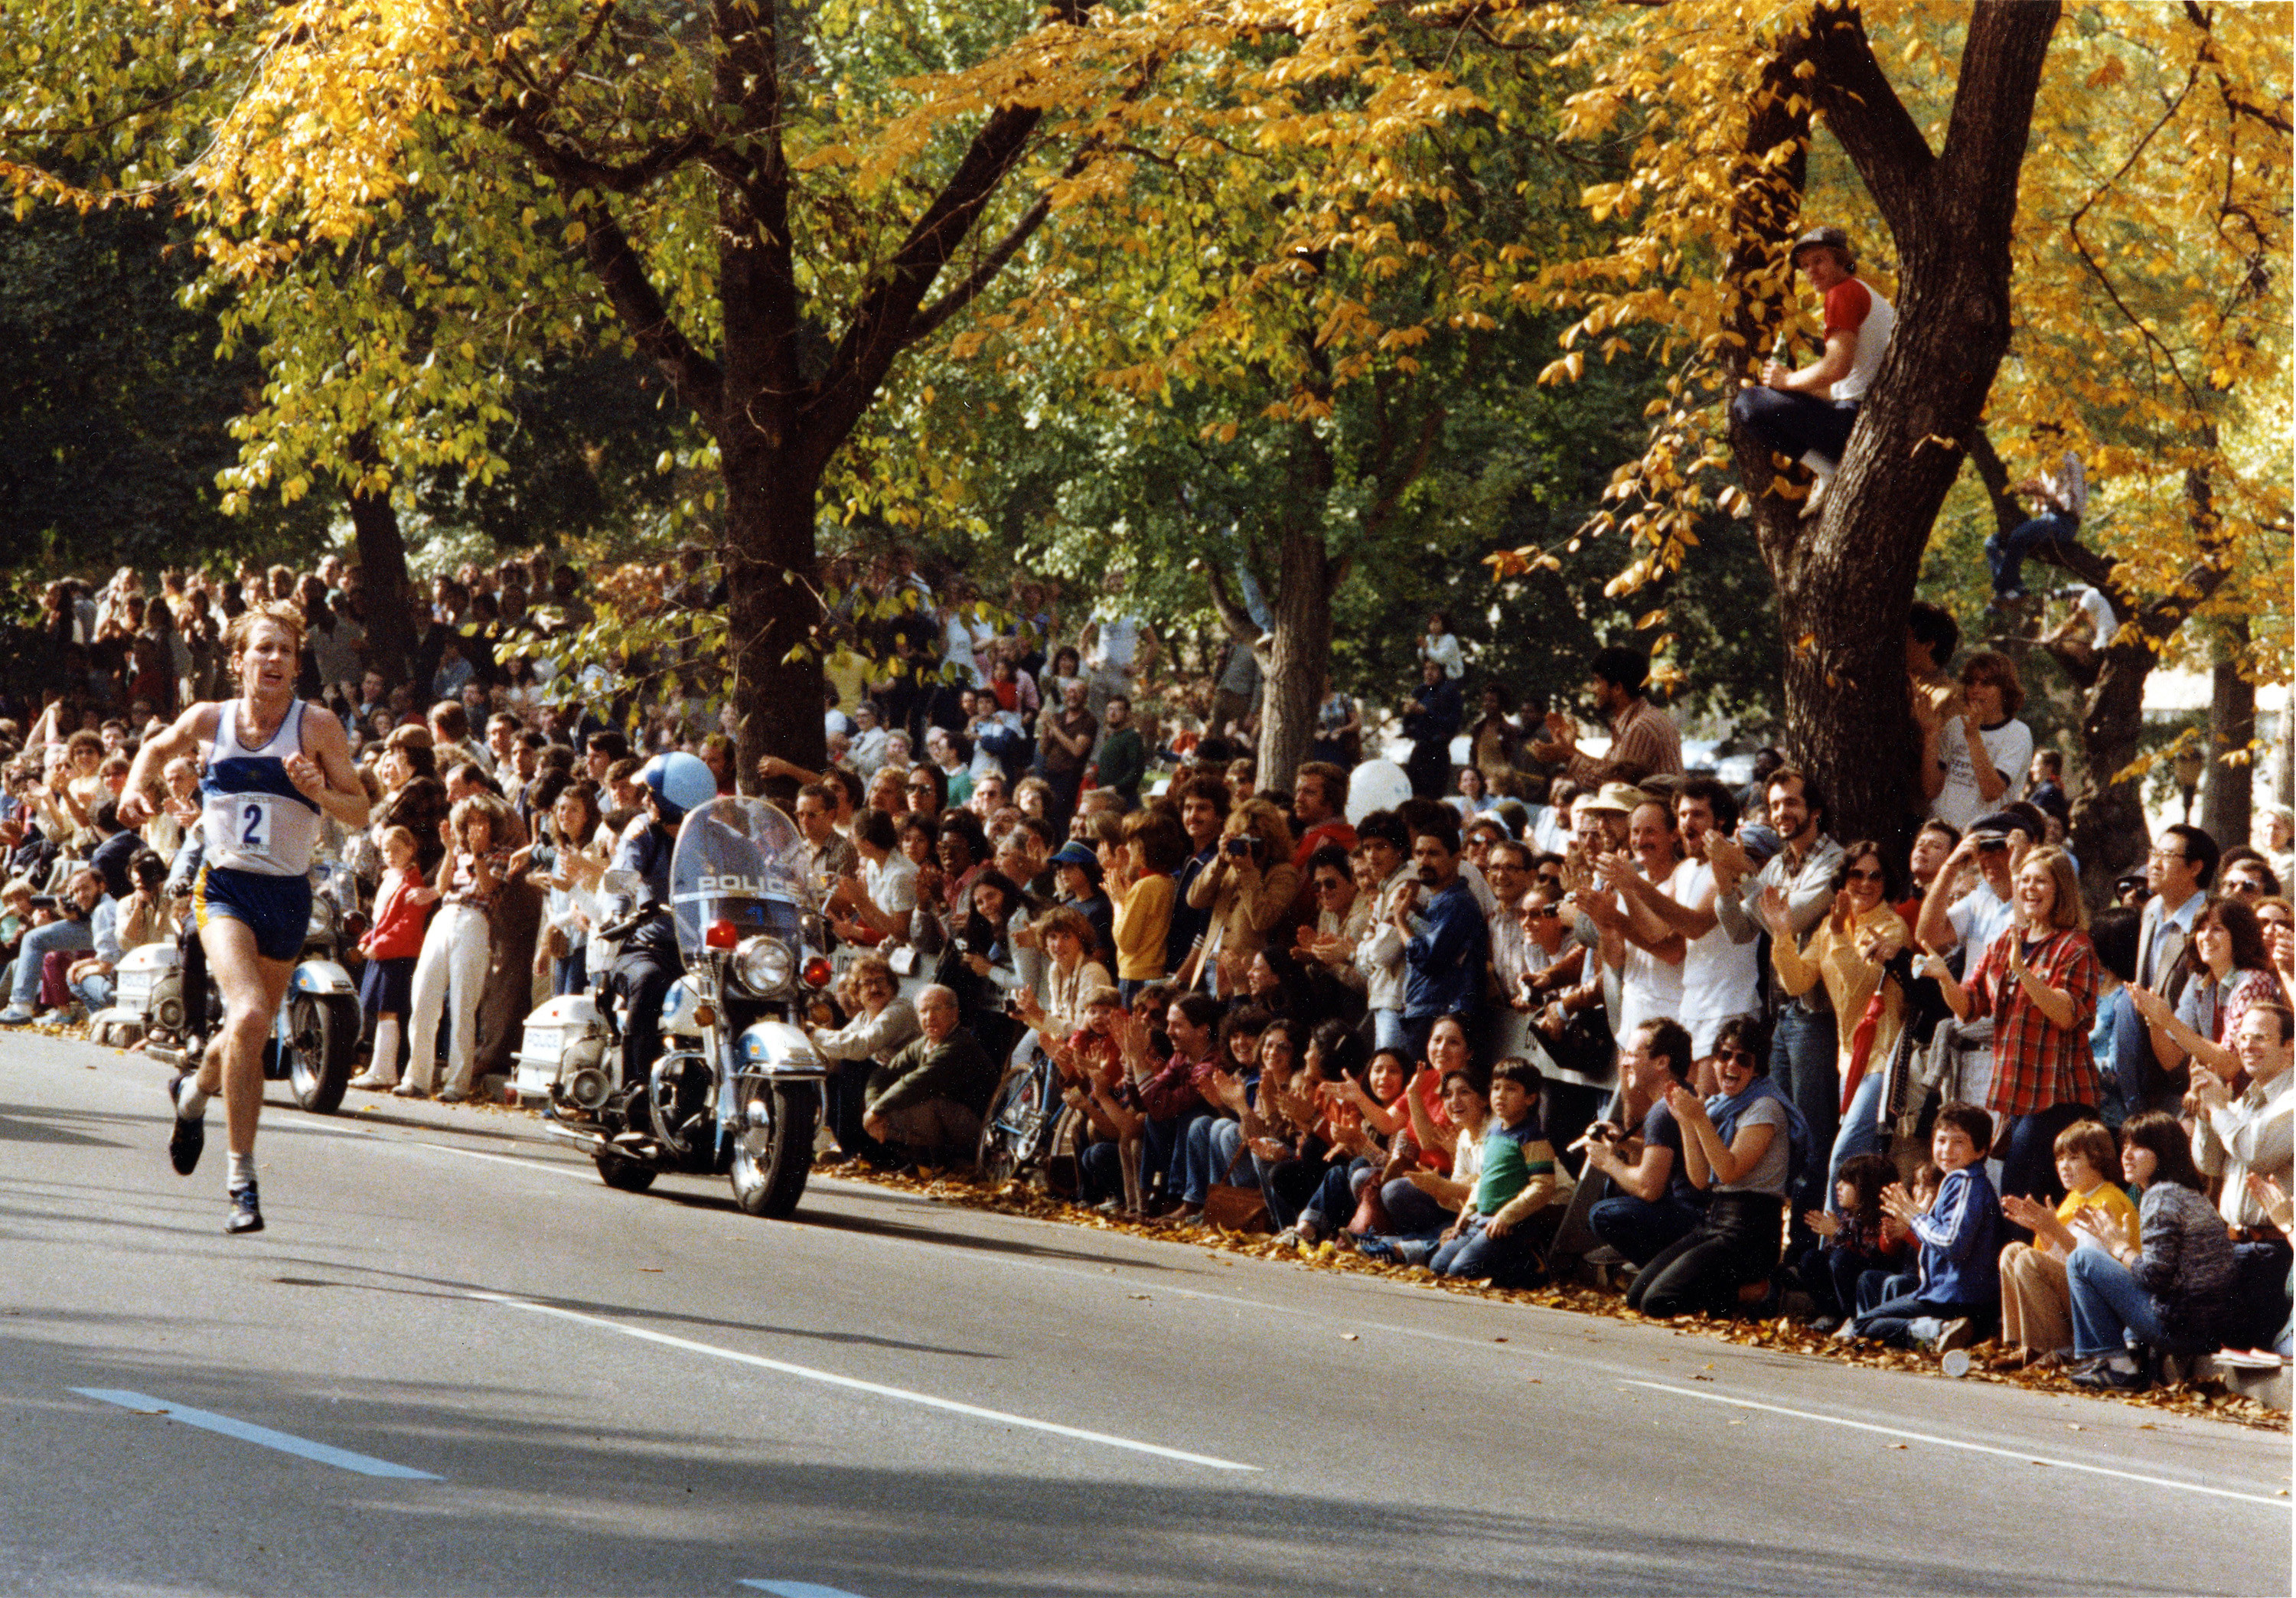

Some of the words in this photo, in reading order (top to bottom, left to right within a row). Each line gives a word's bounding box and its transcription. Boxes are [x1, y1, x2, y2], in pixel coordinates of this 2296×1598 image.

[243, 804, 262, 843] 2
[698, 874, 801, 894] POLICE
[122, 973, 147, 988] POLICE
[527, 1032, 559, 1048] POLICE
